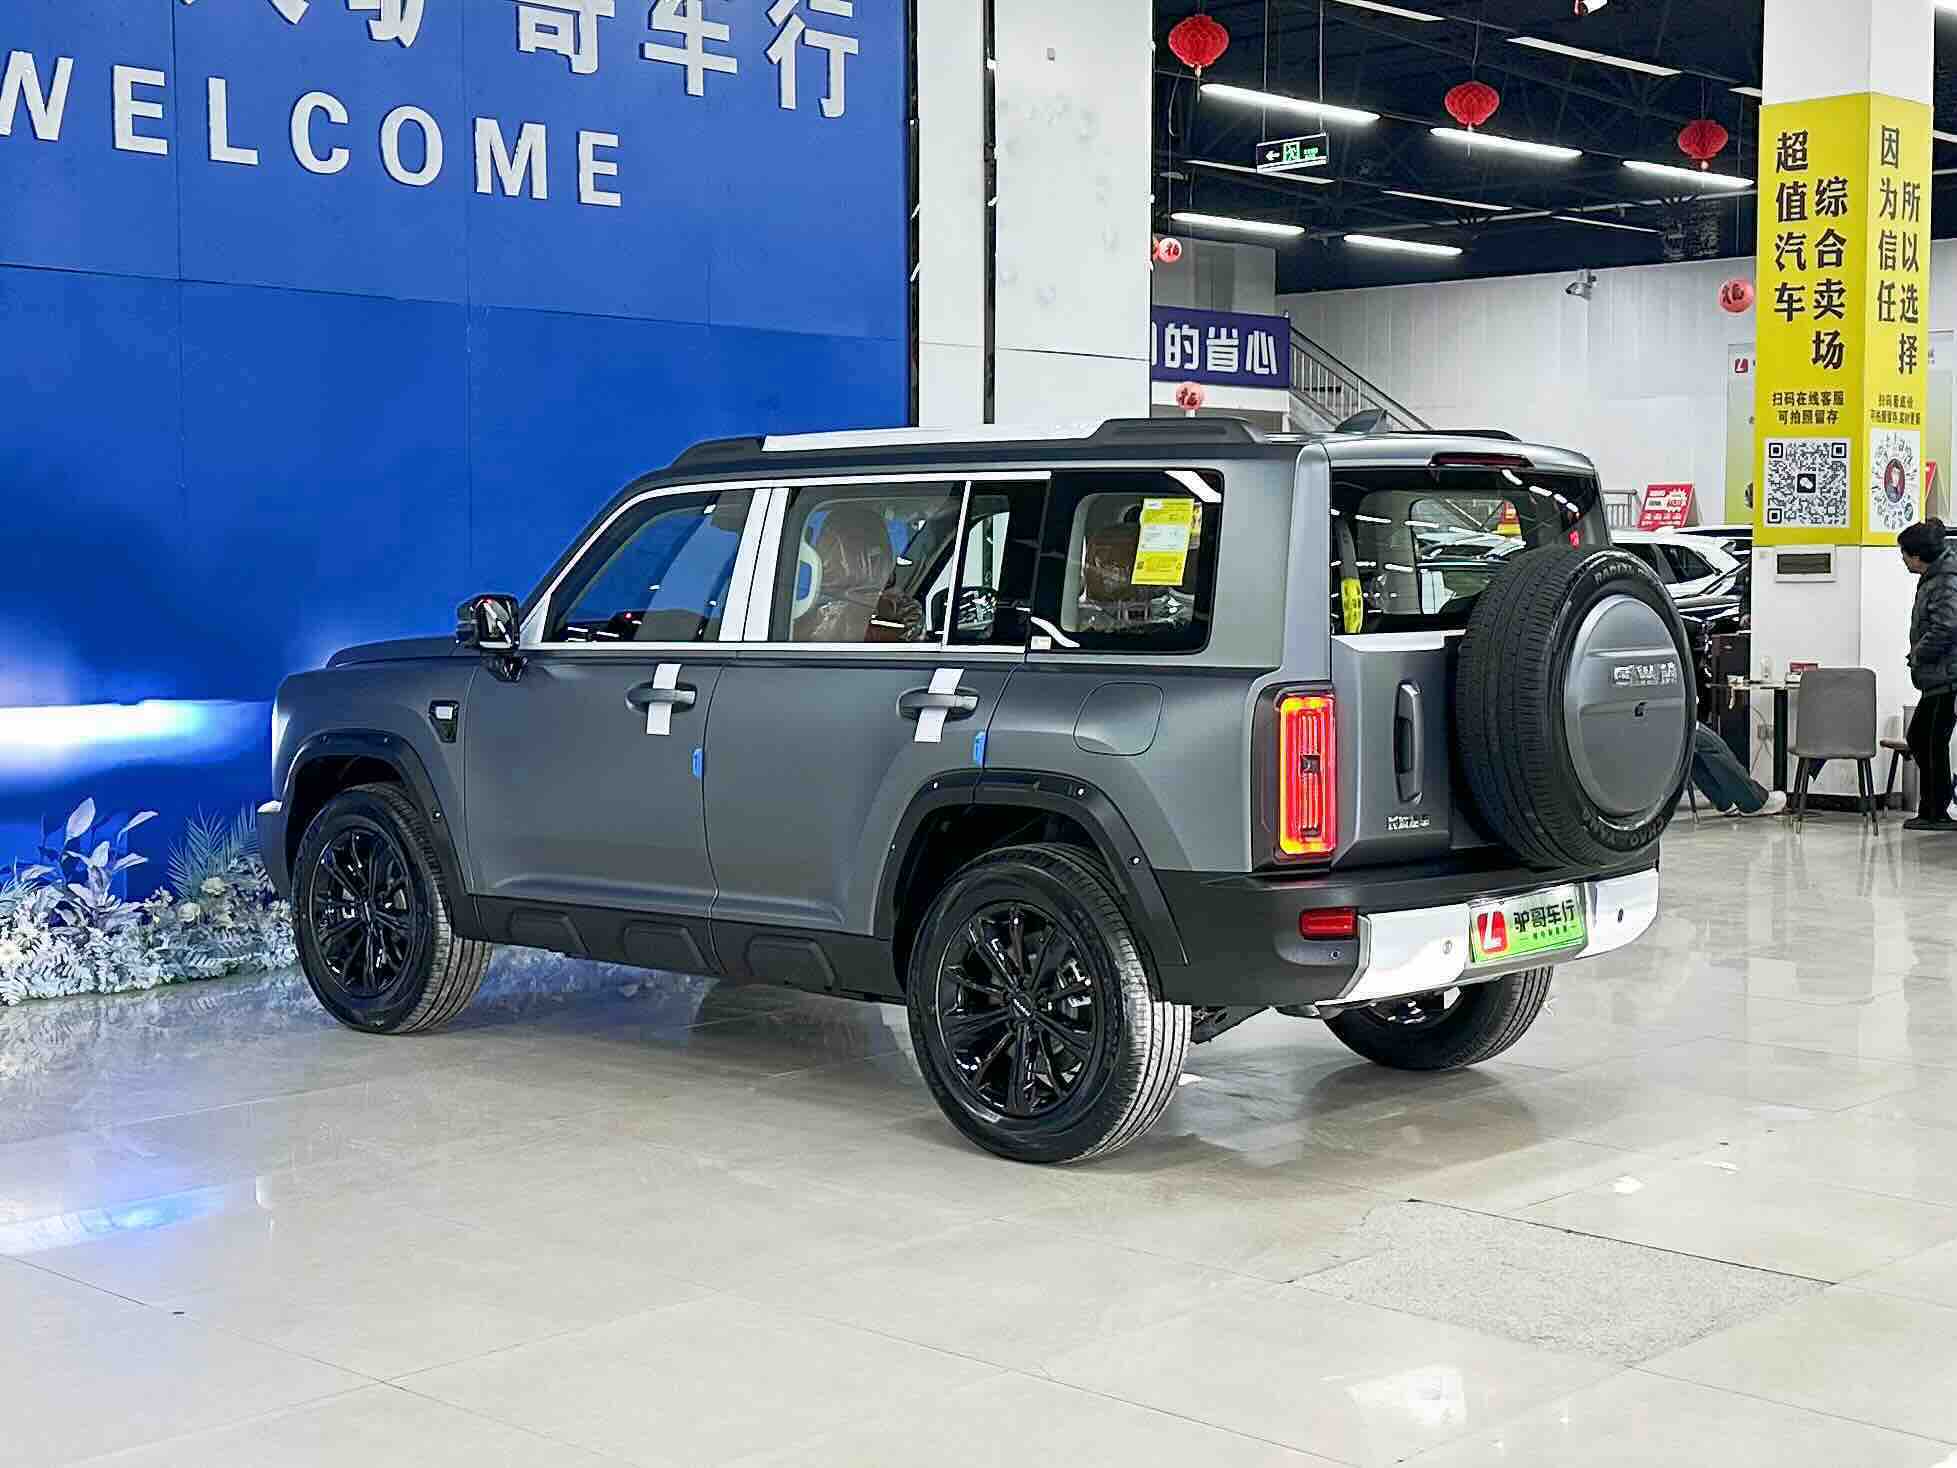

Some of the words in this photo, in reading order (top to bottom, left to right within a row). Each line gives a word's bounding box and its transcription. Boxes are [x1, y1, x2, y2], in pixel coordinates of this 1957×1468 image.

[0, 50, 623, 207] WELCOME
[1774, 129, 1809, 323] 超值汽车
[1811, 175, 1848, 370] 综合卖场
[1877, 125, 1899, 323] 因为信任
[1899, 180, 1920, 375] 所以选择
[1152, 321, 1278, 375] 的省心
[1772, 390, 1845, 407] 扫码在线客服
[1513, 899, 1575, 933] 驴哥车行
